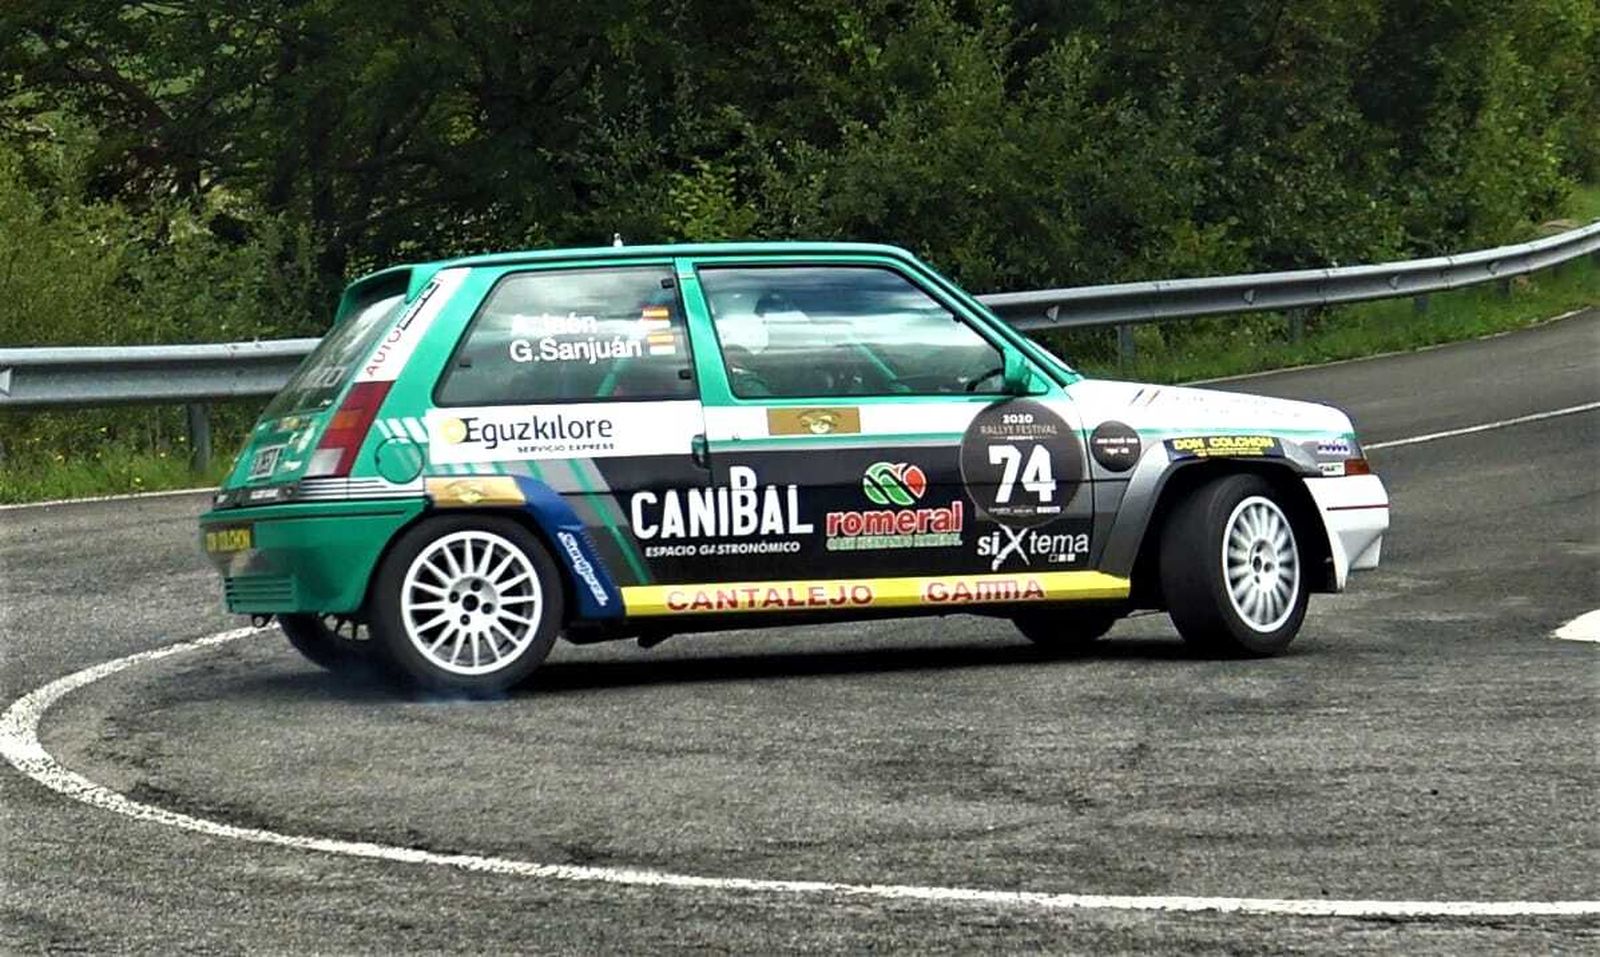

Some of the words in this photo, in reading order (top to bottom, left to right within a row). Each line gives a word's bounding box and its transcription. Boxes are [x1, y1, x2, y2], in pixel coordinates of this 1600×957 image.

[510, 335, 642, 365] G.Sanjuán
[462, 414, 613, 449] Eguzkilore
[1018, 425, 1058, 435] FESTIVAL
[1173, 438, 1205, 450] DON
[1209, 437, 1275, 448] COLCHON
[988, 444, 1057, 503] 74
[826, 501, 963, 537] romeral
[645, 546, 697, 558] ESPACIO
[667, 584, 874, 612] CANTALEJO
